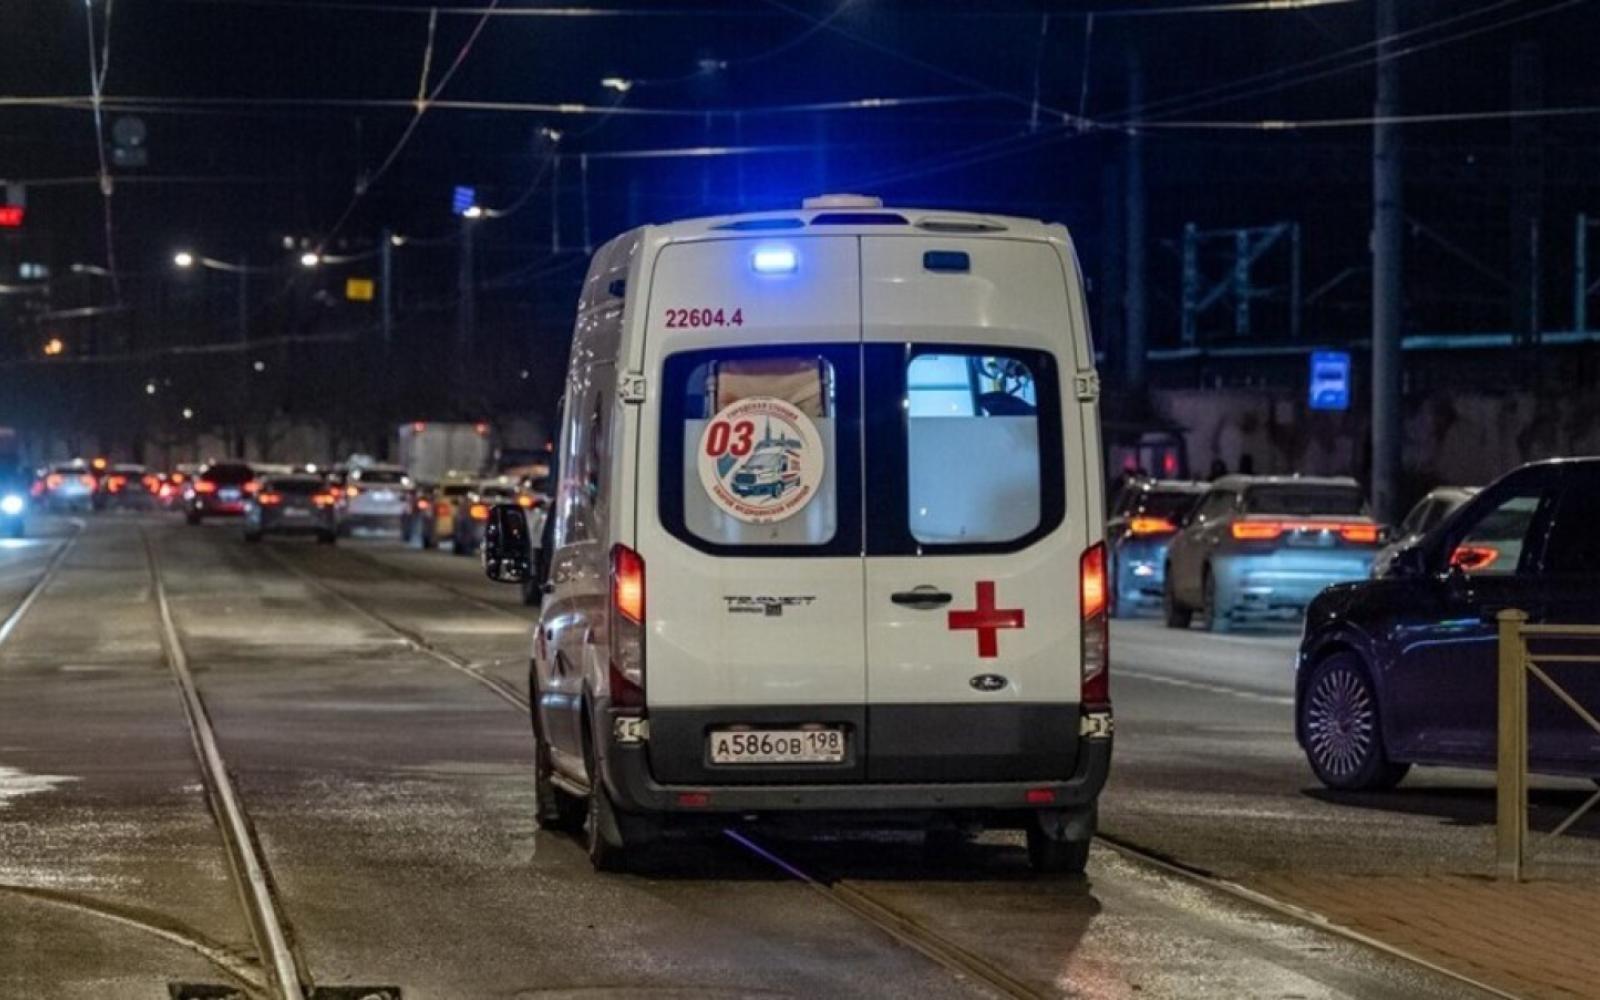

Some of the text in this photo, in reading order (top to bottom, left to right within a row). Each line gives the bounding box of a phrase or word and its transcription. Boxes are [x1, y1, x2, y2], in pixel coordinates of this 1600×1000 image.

[665, 308, 743, 328] 22604.4
[706, 421, 754, 456] 03
[807, 732, 839, 749] 198
